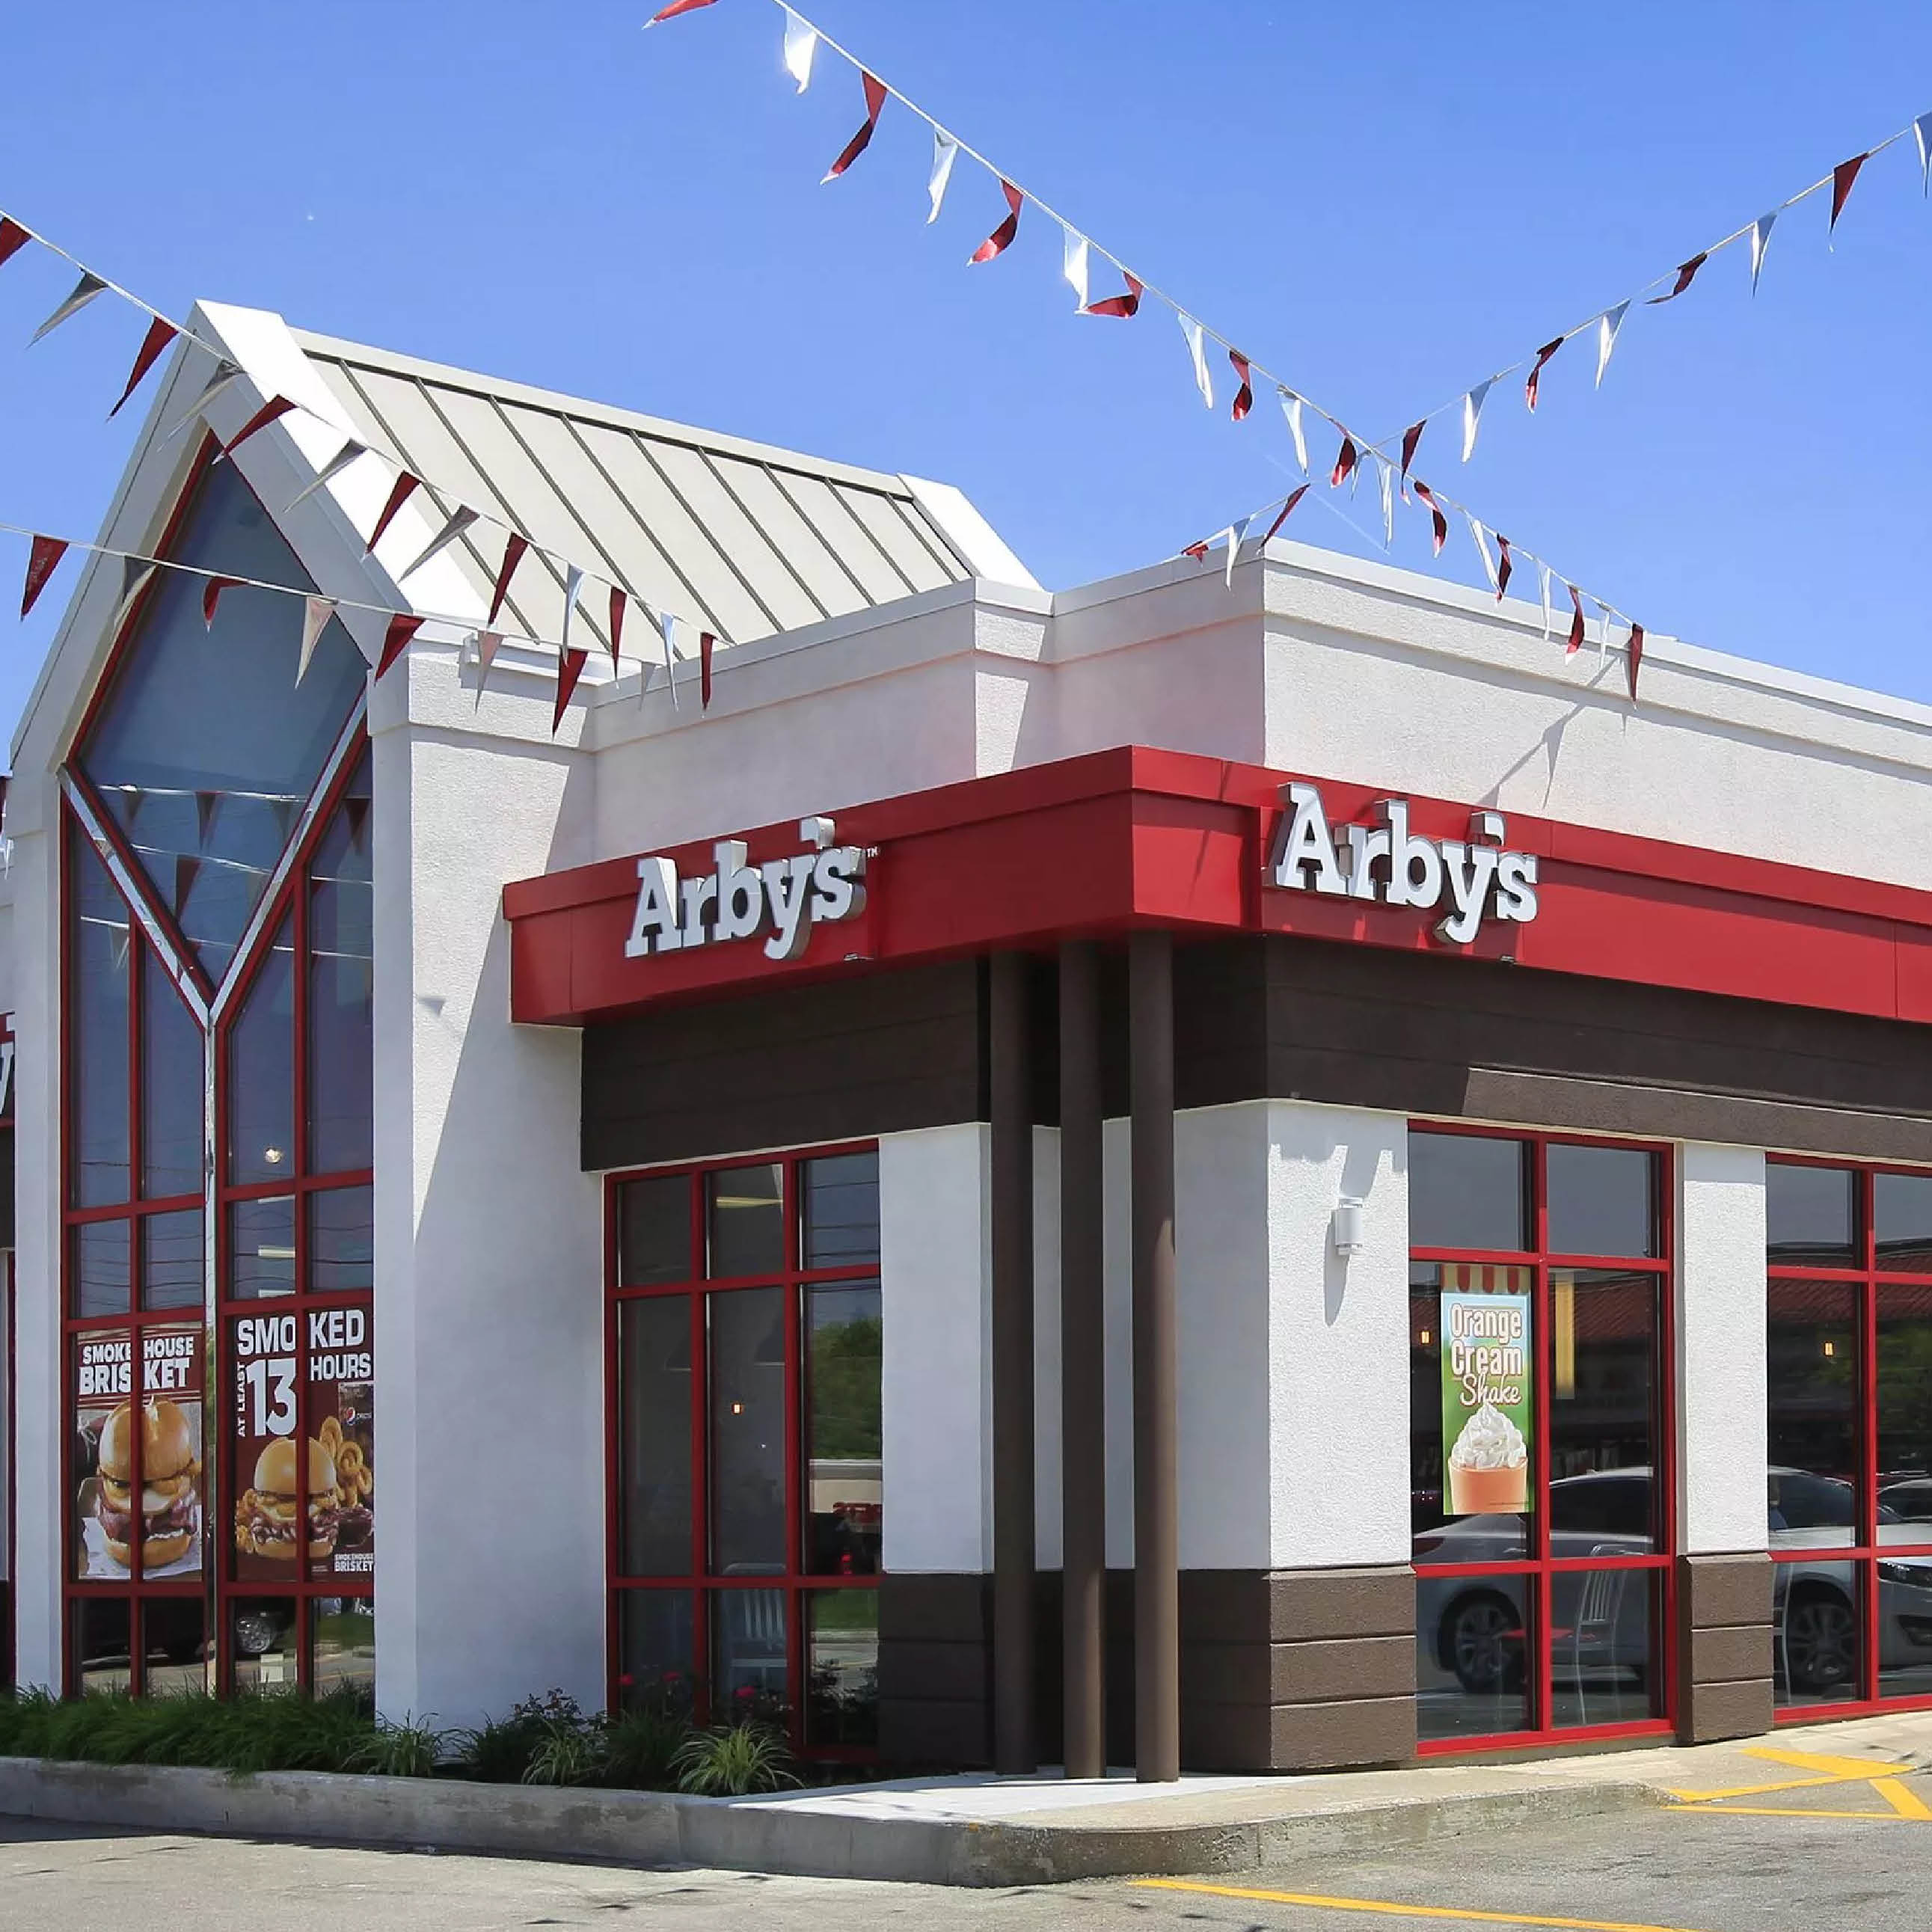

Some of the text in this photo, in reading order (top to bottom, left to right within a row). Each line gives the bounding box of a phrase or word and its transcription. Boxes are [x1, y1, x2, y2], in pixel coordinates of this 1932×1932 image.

[1272, 782, 1539, 944] Arby's
[625, 817, 867, 960] Arby's
[1450, 1302, 1523, 1344] Orange
[310, 1353, 371, 1381] HOURS
[1450, 1340, 1522, 1378] Cream
[246, 1358, 296, 1437] 13
[1459, 1372, 1523, 1406] Shake
[237, 1417, 245, 1437] AT
[334, 1561, 373, 1572] BRISKET
